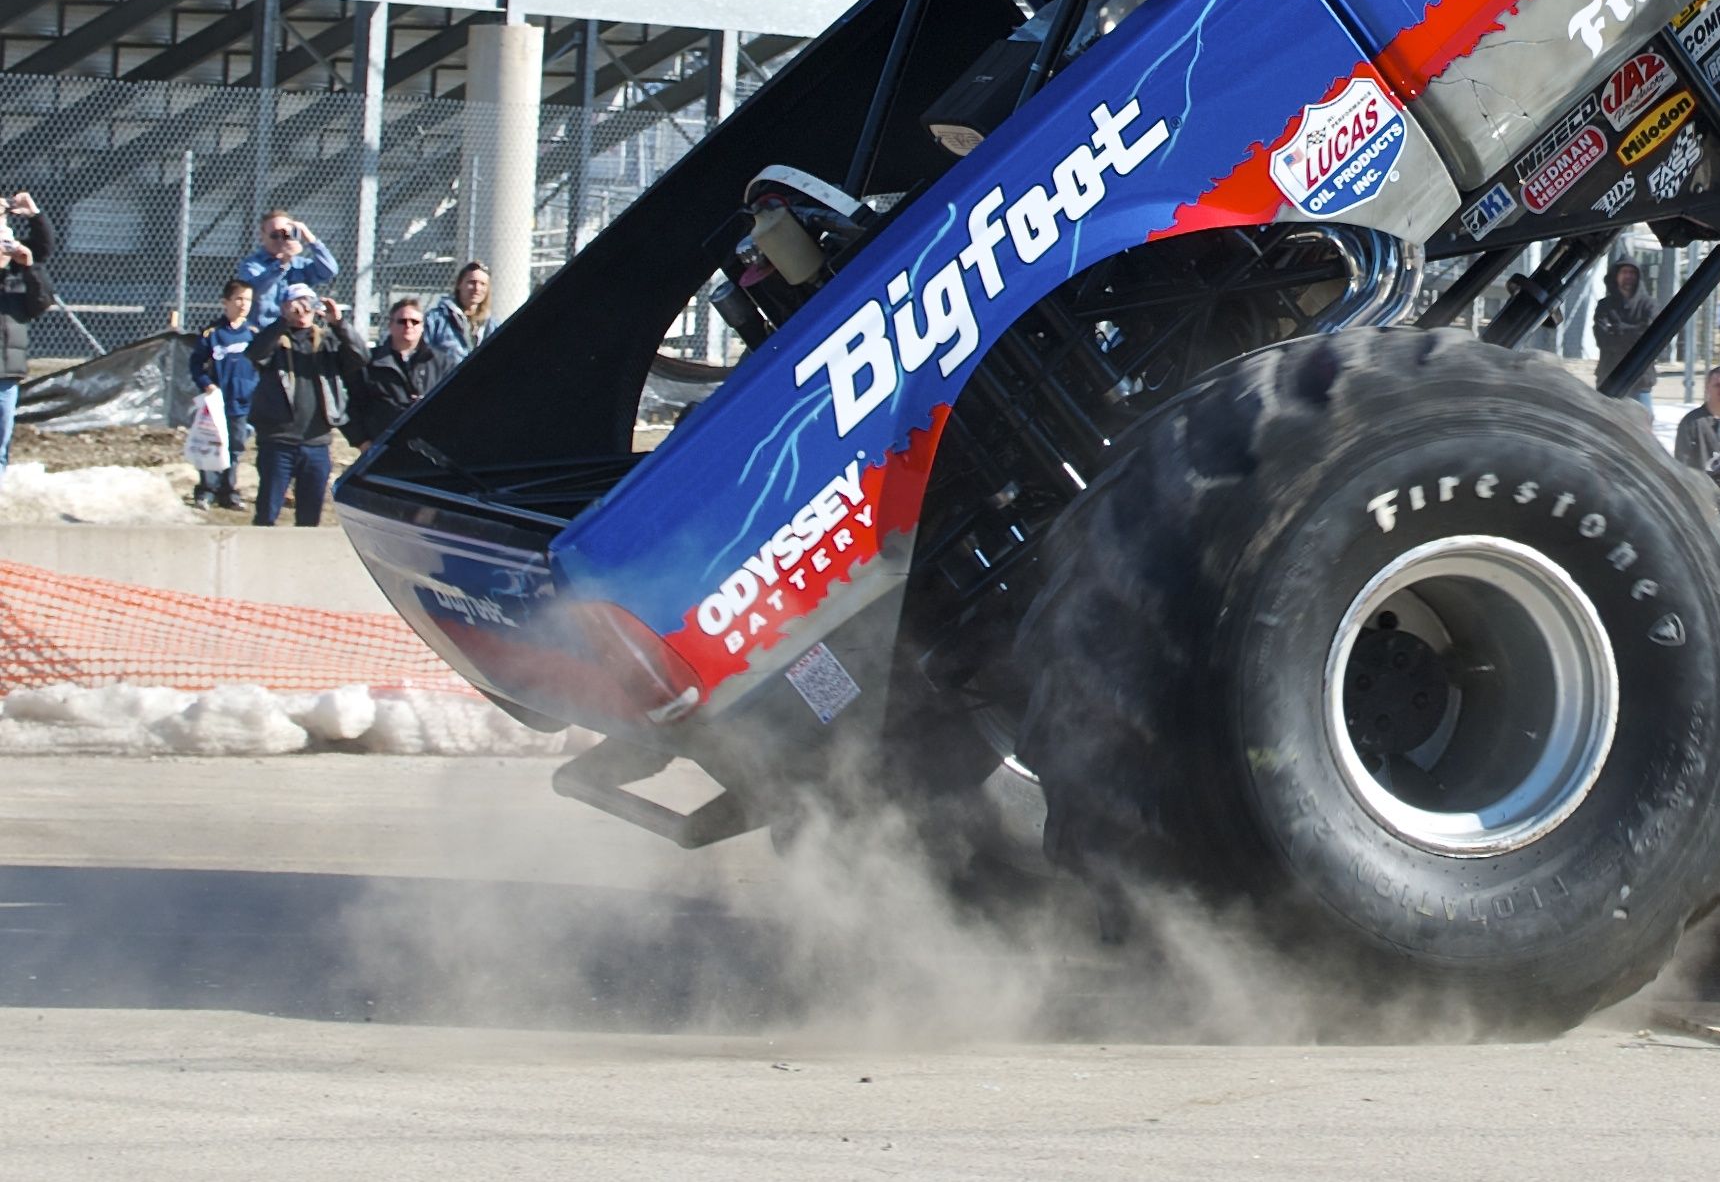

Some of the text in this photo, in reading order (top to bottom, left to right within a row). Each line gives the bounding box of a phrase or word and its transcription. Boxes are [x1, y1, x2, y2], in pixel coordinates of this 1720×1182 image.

[1306, 98, 1379, 191] LUCAS
[1309, 122, 1404, 212] OIL PRODUCTS
[1528, 133, 1594, 198] HEDMAN
[1621, 96, 1693, 162] Milodon
[1352, 168, 1383, 196] INC.
[1480, 185, 1513, 220] K1
[1536, 145, 1600, 208] HEDDERS
[795, 97, 1175, 438] Bigfoot
[696, 459, 867, 635] ODYSSEY
[723, 504, 875, 654] BATTERY
[1366, 473, 1660, 603] Firestone
